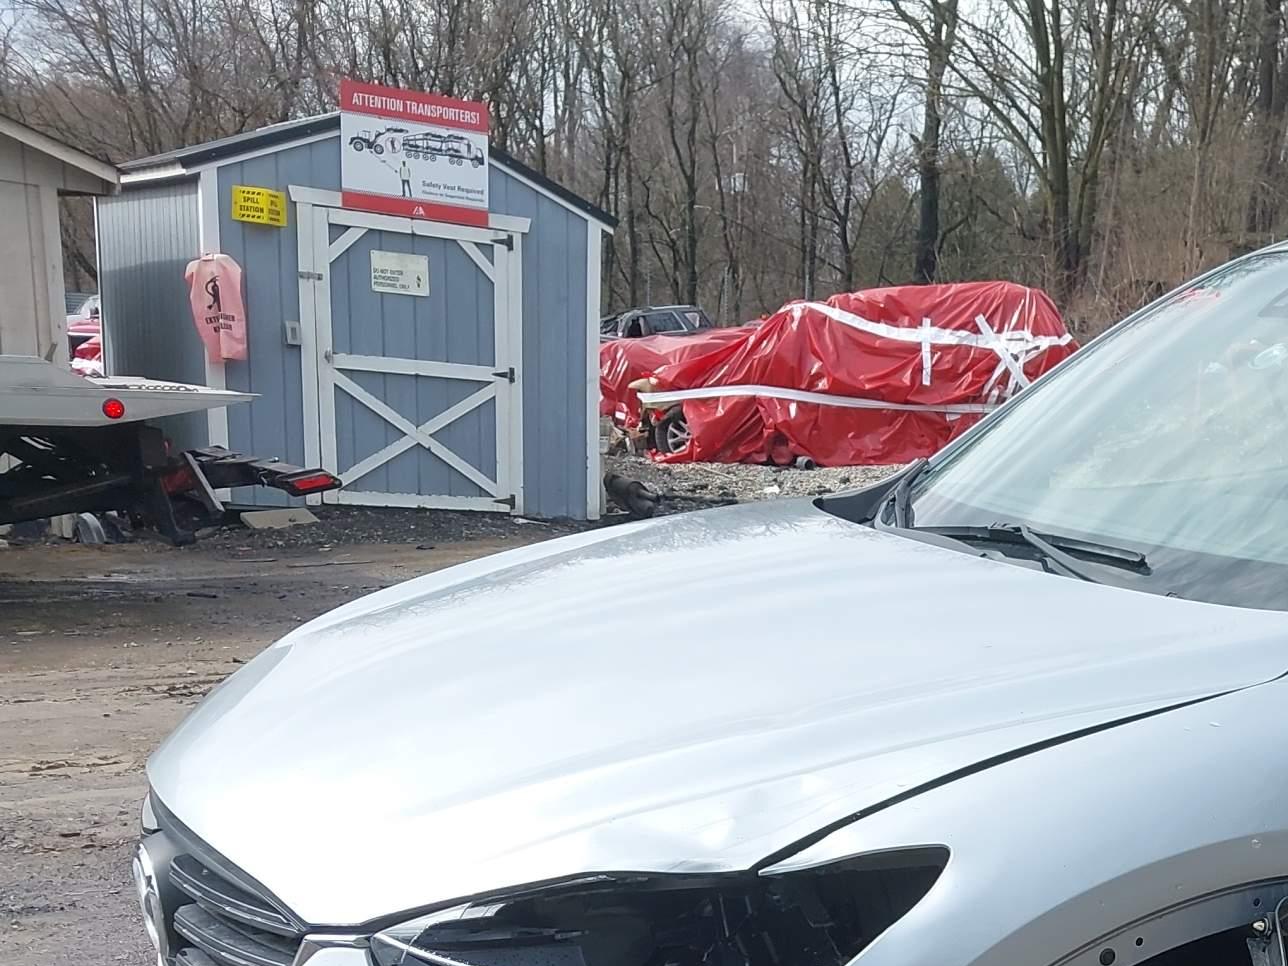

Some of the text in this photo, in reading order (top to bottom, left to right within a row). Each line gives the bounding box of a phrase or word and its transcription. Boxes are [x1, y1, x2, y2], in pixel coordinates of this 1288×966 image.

[352, 92, 480, 124] ATTENTION TRANSPORTERS!
[422, 180, 484, 195] Safety Vest Required
[243, 196, 260, 204] SPILL
[239, 204, 264, 214] STATION
